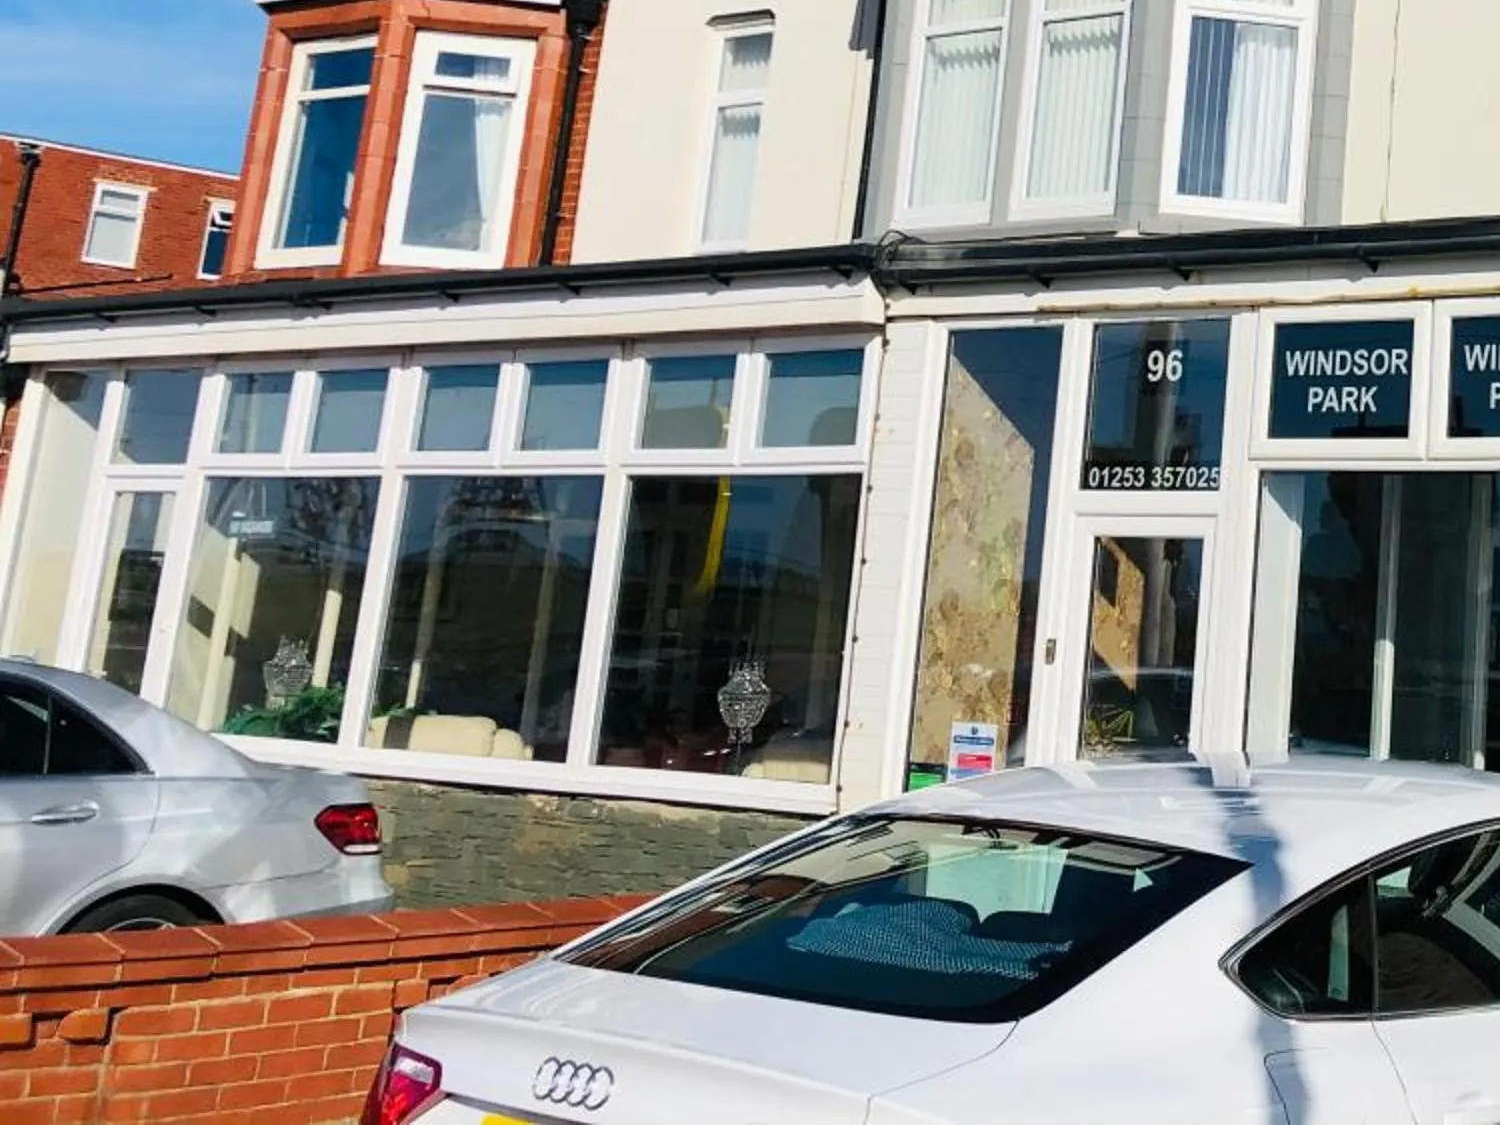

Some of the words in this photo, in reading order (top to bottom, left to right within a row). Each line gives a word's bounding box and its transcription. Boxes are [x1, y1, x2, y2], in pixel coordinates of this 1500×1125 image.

[1147, 349, 1184, 382] 96
[1285, 347, 1409, 377] WINDSOR
[1307, 386, 1379, 413] PARK
[1088, 466, 1145, 488] 01253
[1151, 466, 1220, 488] 357025
